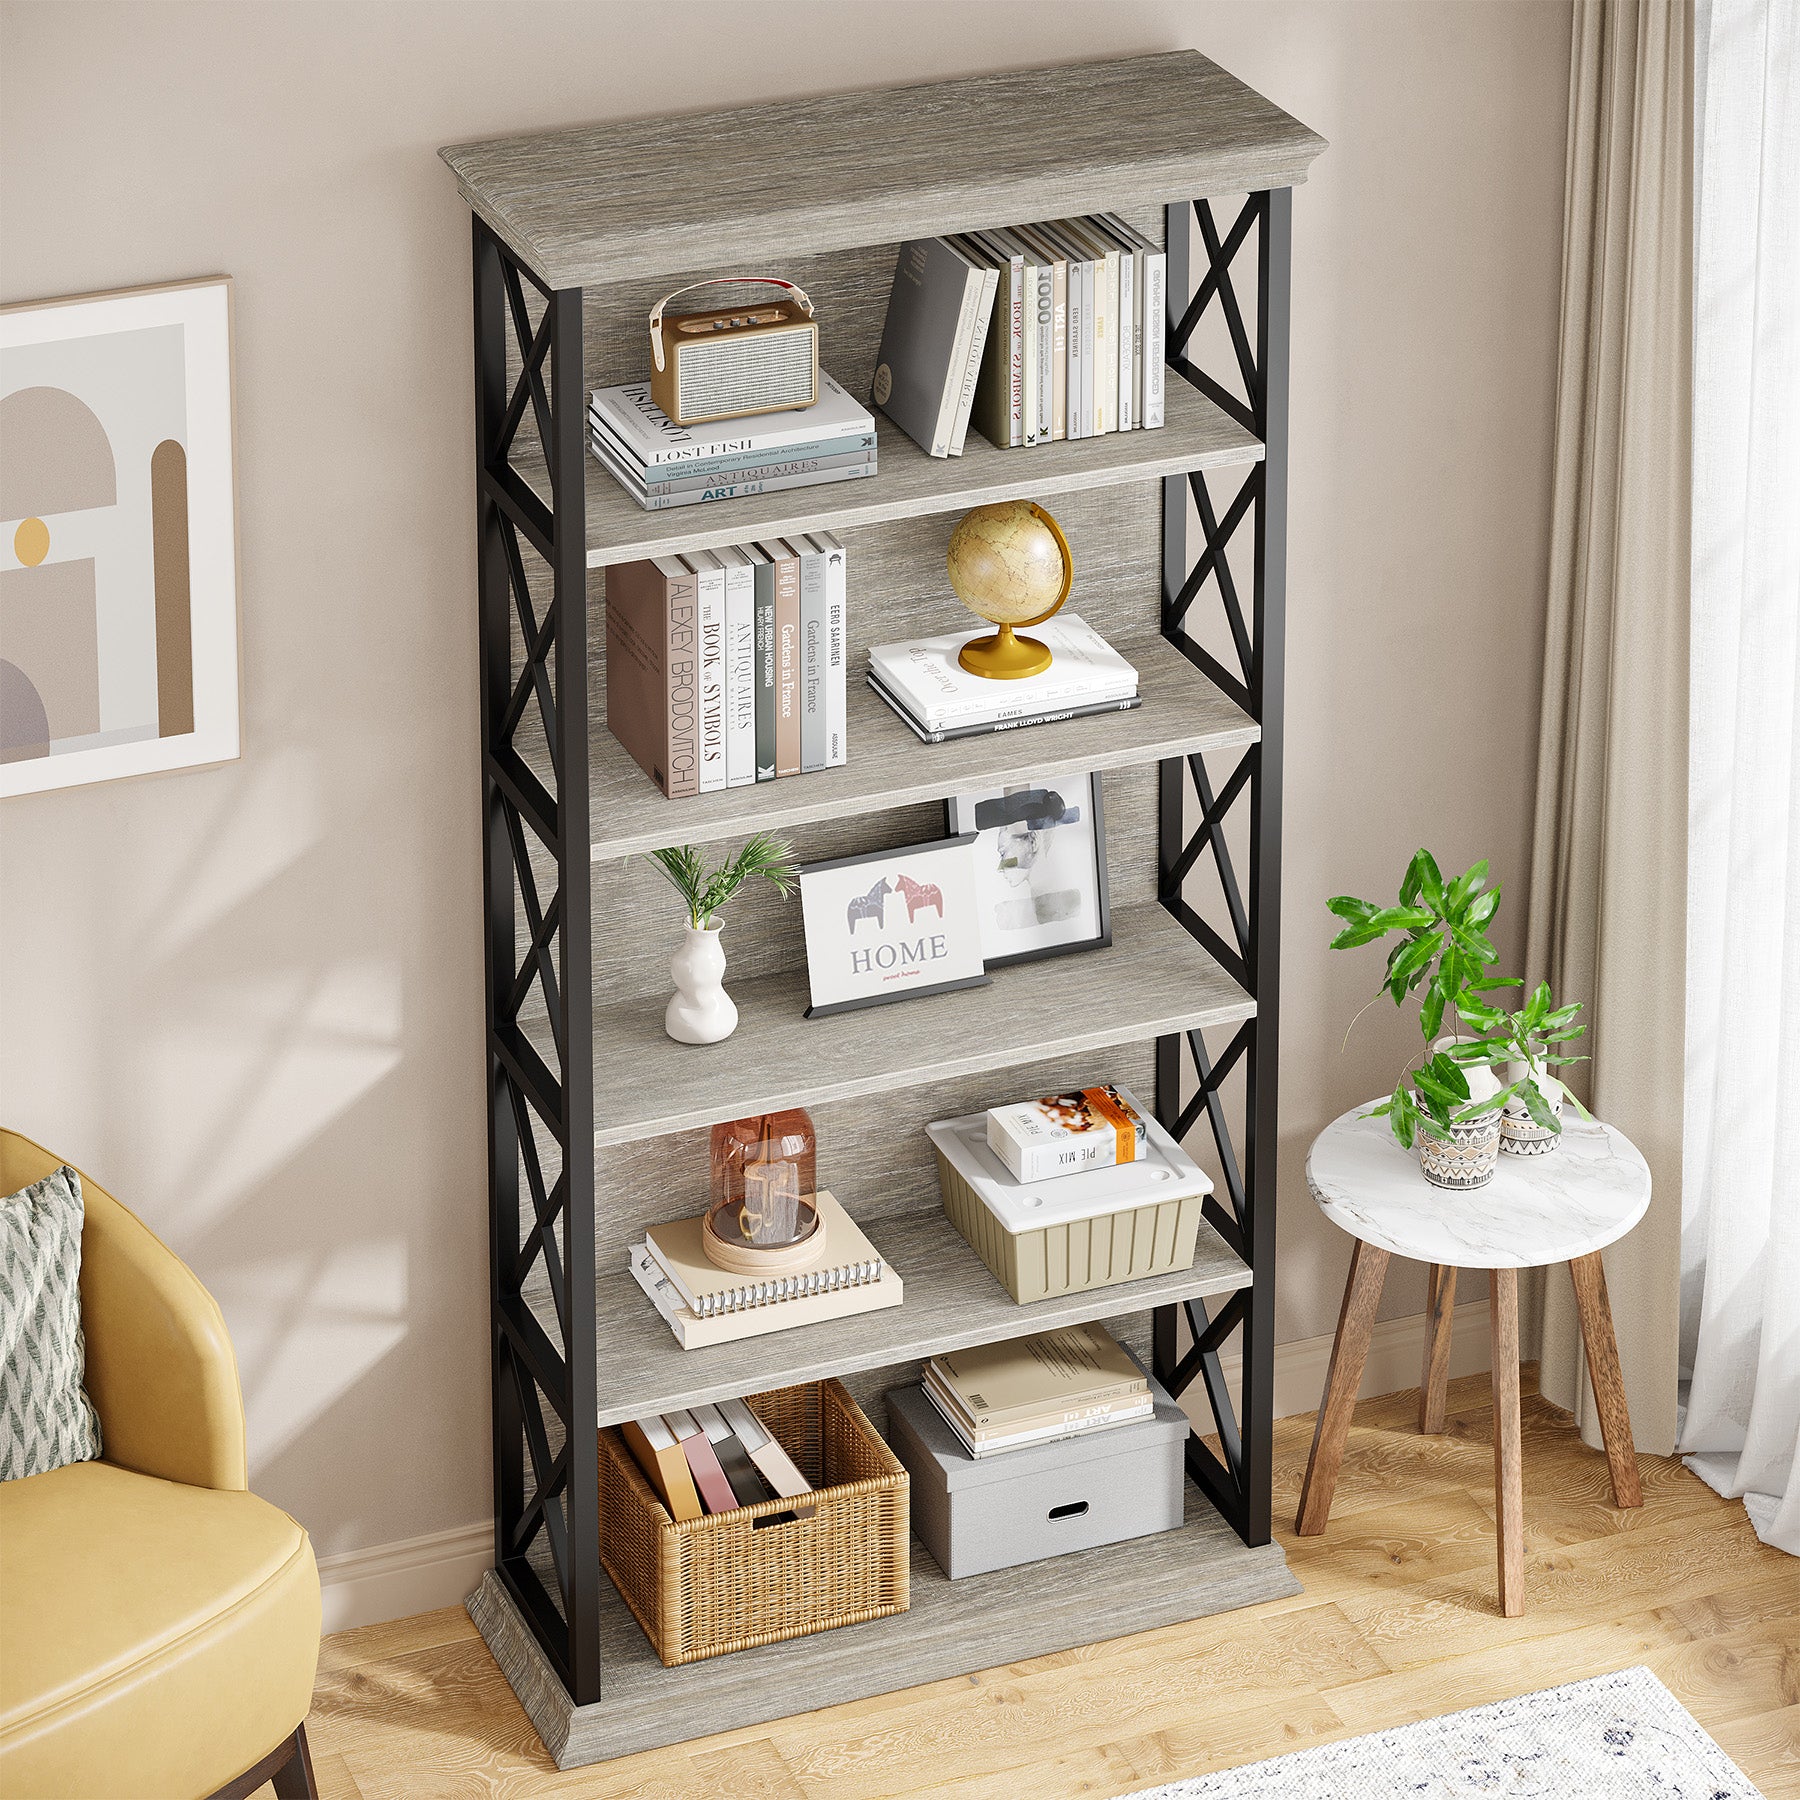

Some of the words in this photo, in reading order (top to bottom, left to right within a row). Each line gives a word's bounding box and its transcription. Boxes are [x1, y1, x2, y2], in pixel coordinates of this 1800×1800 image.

[655, 447, 704, 463] LOST
[710, 439, 752, 455] FISH
[666, 463, 685, 472] Detail
[694, 456, 742, 469] Contemporary
[743, 449, 779, 460] Residential
[780, 444, 820, 455] Architecture
[666, 470, 691, 478] Virginia
[693, 465, 720, 475] McLeod
[706, 460, 819, 484] ANTIQUAIRES
[701, 486, 737, 500] ART
[671, 583, 693, 653] ALEXEY
[702, 604, 712, 621] THE
[764, 605, 773, 623] NEW
[830, 604, 839, 624] EERO
[703, 622, 720, 668] BOOK
[764, 624, 773, 651] URBAN
[781, 624, 794, 667] Gardens
[807, 620, 819, 663] Gardens
[830, 627, 840, 667] SAARINEN
[909, 647, 928, 664] Top
[704, 671, 712, 681] OF
[737, 622, 752, 730] ANTIQUAIRES
[764, 651, 774, 687] HOUSING
[782, 669, 793, 680] in
[807, 664, 818, 675] in
[935, 676, 959, 693] Over
[782, 681, 794, 718] France
[807, 678, 819, 713] France
[671, 660, 694, 785] BRODOVITCH
[703, 683, 721, 762] SYMBOLS
[994, 720, 1018, 731] FRANK
[1019, 716, 1043, 727] LLOYD
[1043, 712, 1074, 722] WRIGHT
[997, 709, 1023, 719] EAMES
[850, 934, 948, 974] HOME
[1018, 1113, 1031, 1126] MIX
[1029, 1125, 1041, 1135] PIE
[1058, 1151, 1076, 1165] MIX
[1081, 1147, 1096, 1160] PIE
[1083, 1404, 1112, 1419] ART
[1085, 1415, 1111, 1426] ART
